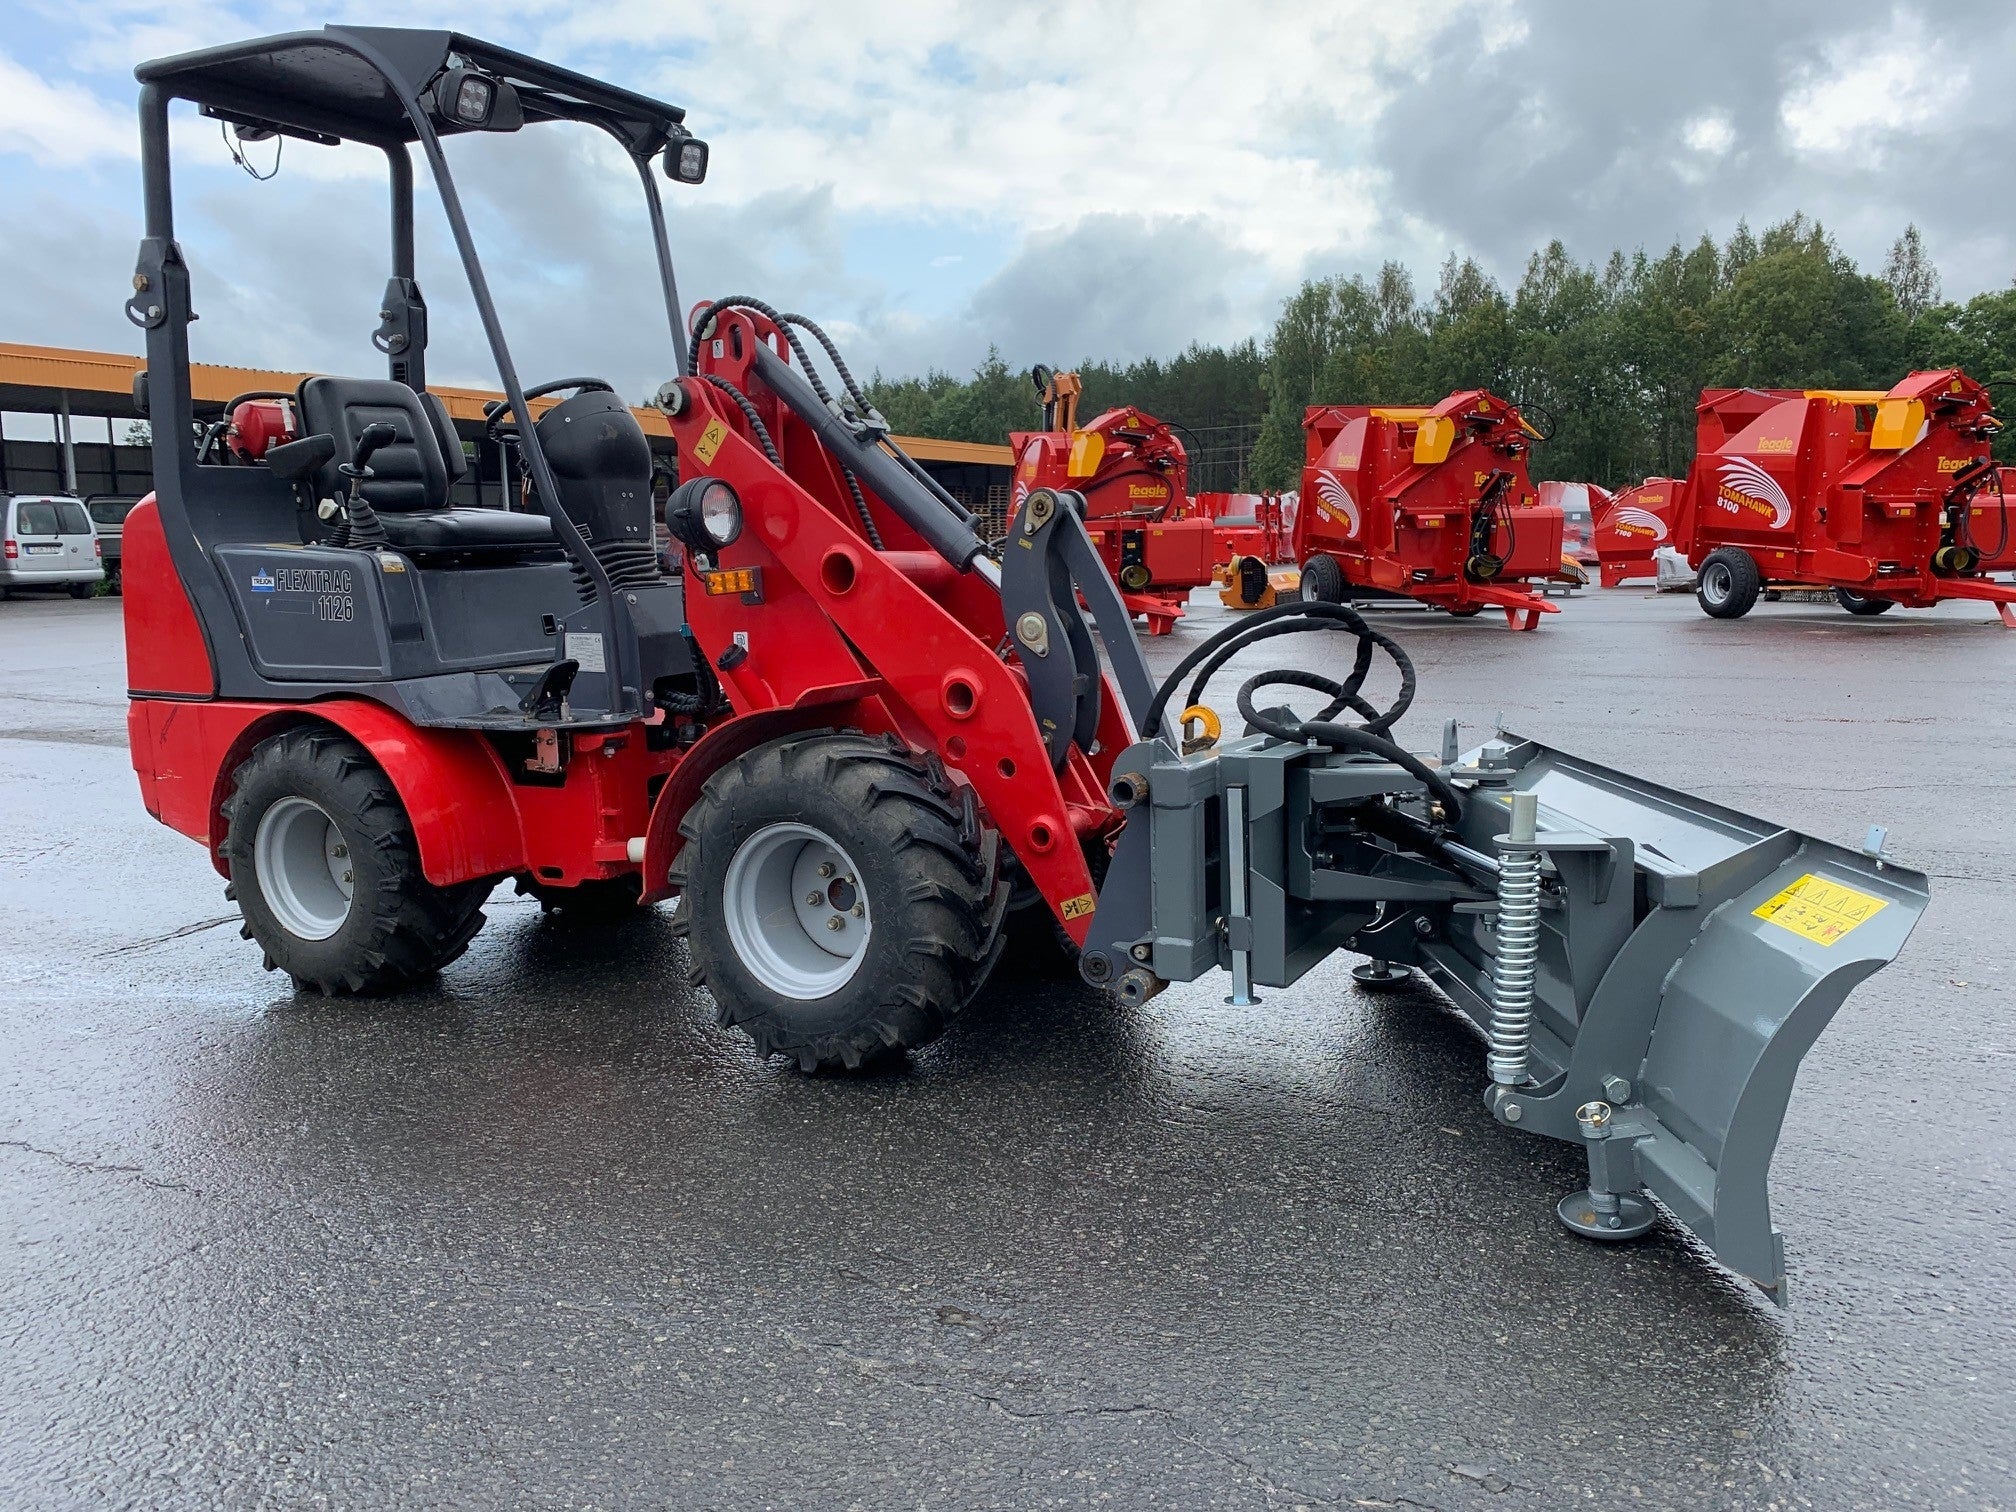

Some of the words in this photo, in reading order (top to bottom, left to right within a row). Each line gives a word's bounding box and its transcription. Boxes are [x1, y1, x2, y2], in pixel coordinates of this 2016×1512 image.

[1757, 436, 1793, 453] Teagle
[1128, 484, 1167, 498] Teagle
[1716, 496, 1739, 514] 8100
[1718, 485, 1774, 518] TOMAHAWK
[1614, 528, 1632, 538] 7100
[1615, 522, 1655, 537] TOMAHAWK
[275, 568, 352, 594] FLEXITRAC
[318, 595, 354, 622] 1126
